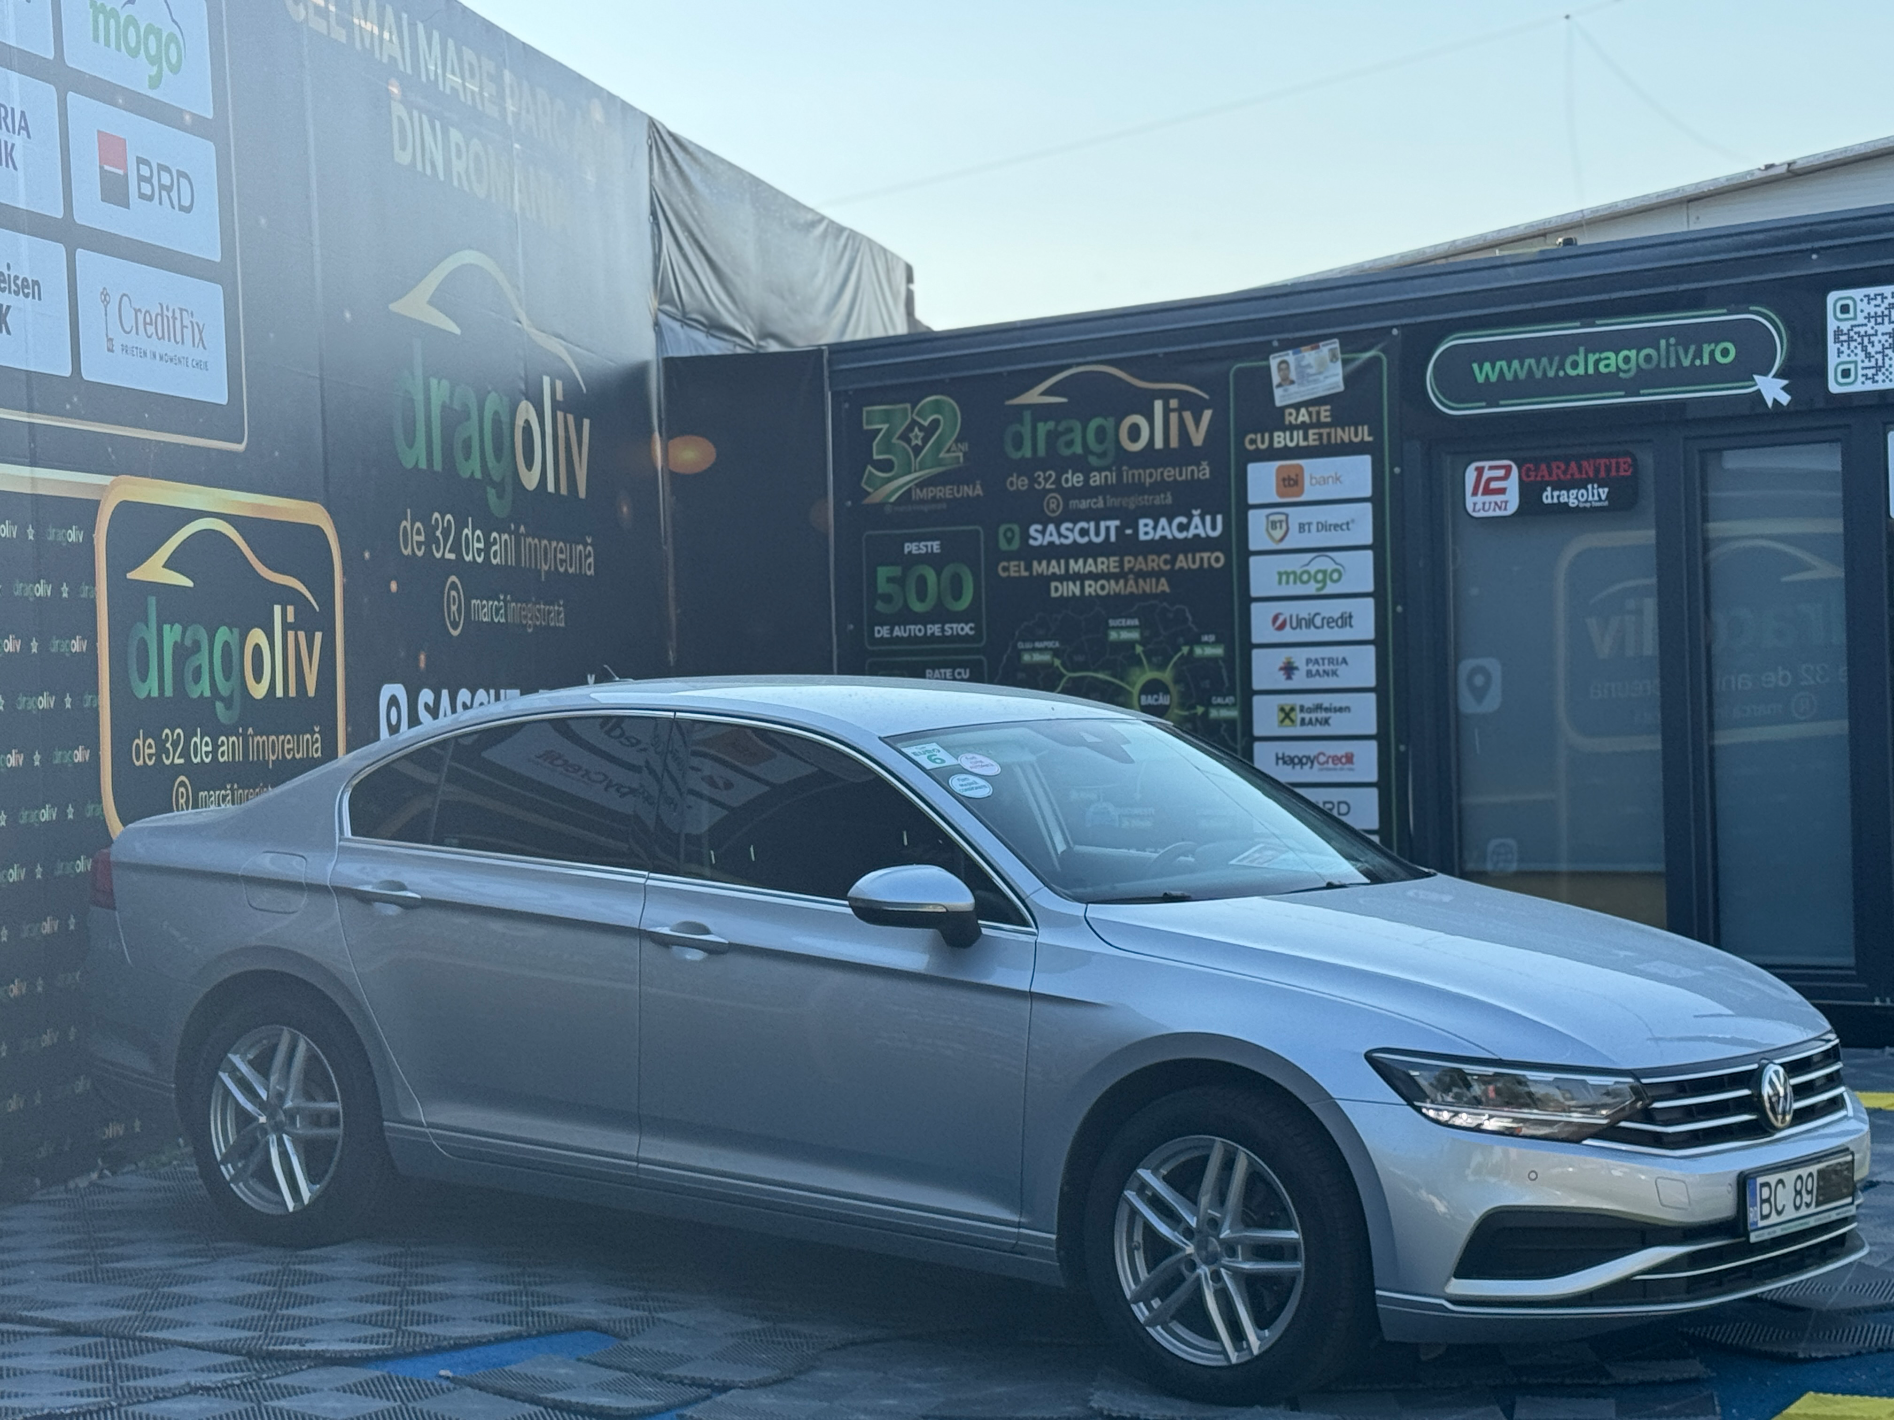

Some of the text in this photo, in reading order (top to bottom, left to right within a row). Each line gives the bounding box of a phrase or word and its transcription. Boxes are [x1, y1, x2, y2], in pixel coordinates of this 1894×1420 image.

[89, 0, 183, 90] mogo
[352, 0, 412, 75] MAI
[416, 20, 499, 121] MARE
[390, 99, 444, 182] DIN
[136, 155, 194, 214] BRD
[117, 292, 207, 350] CreditFix
[1472, 337, 1736, 384] www.dragoliv.ro
[1284, 405, 1331, 425] RATE
[393, 338, 590, 519] dragoliv
[1003, 399, 1213, 467] dragoliv
[1244, 425, 1373, 450] CU BULETINUL
[861, 395, 961, 493] 32
[1006, 461, 1210, 491] de 32 de ani împreună
[1281, 472, 1343, 488] tbi bank
[1471, 464, 1512, 497] 12
[1521, 457, 1633, 482] GARANTIE
[911, 480, 984, 501] ÎMPREUNĂ
[1068, 494, 1105, 510] marcă
[1106, 492, 1172, 512] înregistrată
[1542, 483, 1609, 508] dragoliv
[1472, 500, 1508, 513] LUNI
[46, 523, 84, 546] dragoliv
[1028, 520, 1120, 547] SASCUT
[1138, 509, 1223, 541] BACĂU
[1270, 519, 1285, 531] BT
[1298, 519, 1351, 534] BT Direct
[400, 508, 595, 581] de 32 de ani împreună
[904, 540, 941, 555] PESTE
[998, 552, 1225, 578] CEL MAI MARE PARC AUTO
[13, 579, 52, 601] dragoliv
[875, 562, 974, 614] 500
[1050, 575, 1170, 598] DIN ROMÂNIA
[1277, 567, 1343, 592] mogo
[471, 594, 505, 623] marcă
[506, 594, 565, 632] înregistrată
[1289, 611, 1354, 630] UniCredit
[874, 623, 975, 638] DE AUTO PE STOC
[50, 635, 87, 657] dragoliv
[127, 596, 322, 725] dragoliv
[1305, 656, 1348, 668] PATRIA
[925, 668, 970, 680] RATE CU
[1305, 668, 1339, 679] BANK
[17, 691, 56, 715] dragoliv
[1140, 692, 1171, 706] BACĂU
[1298, 703, 1352, 715] Raiffeisen
[1299, 716, 1331, 727] BANK
[52, 745, 90, 768] dragoliv
[132, 725, 321, 770] de 32 de ani împreună
[927, 754, 946, 764] 6
[1275, 751, 1355, 770] HappyCredit
[198, 783, 232, 808] marcă
[18, 803, 58, 828] dragoliv
[1316, 800, 1350, 817] RD
[1759, 1171, 1814, 1221] BC 89
